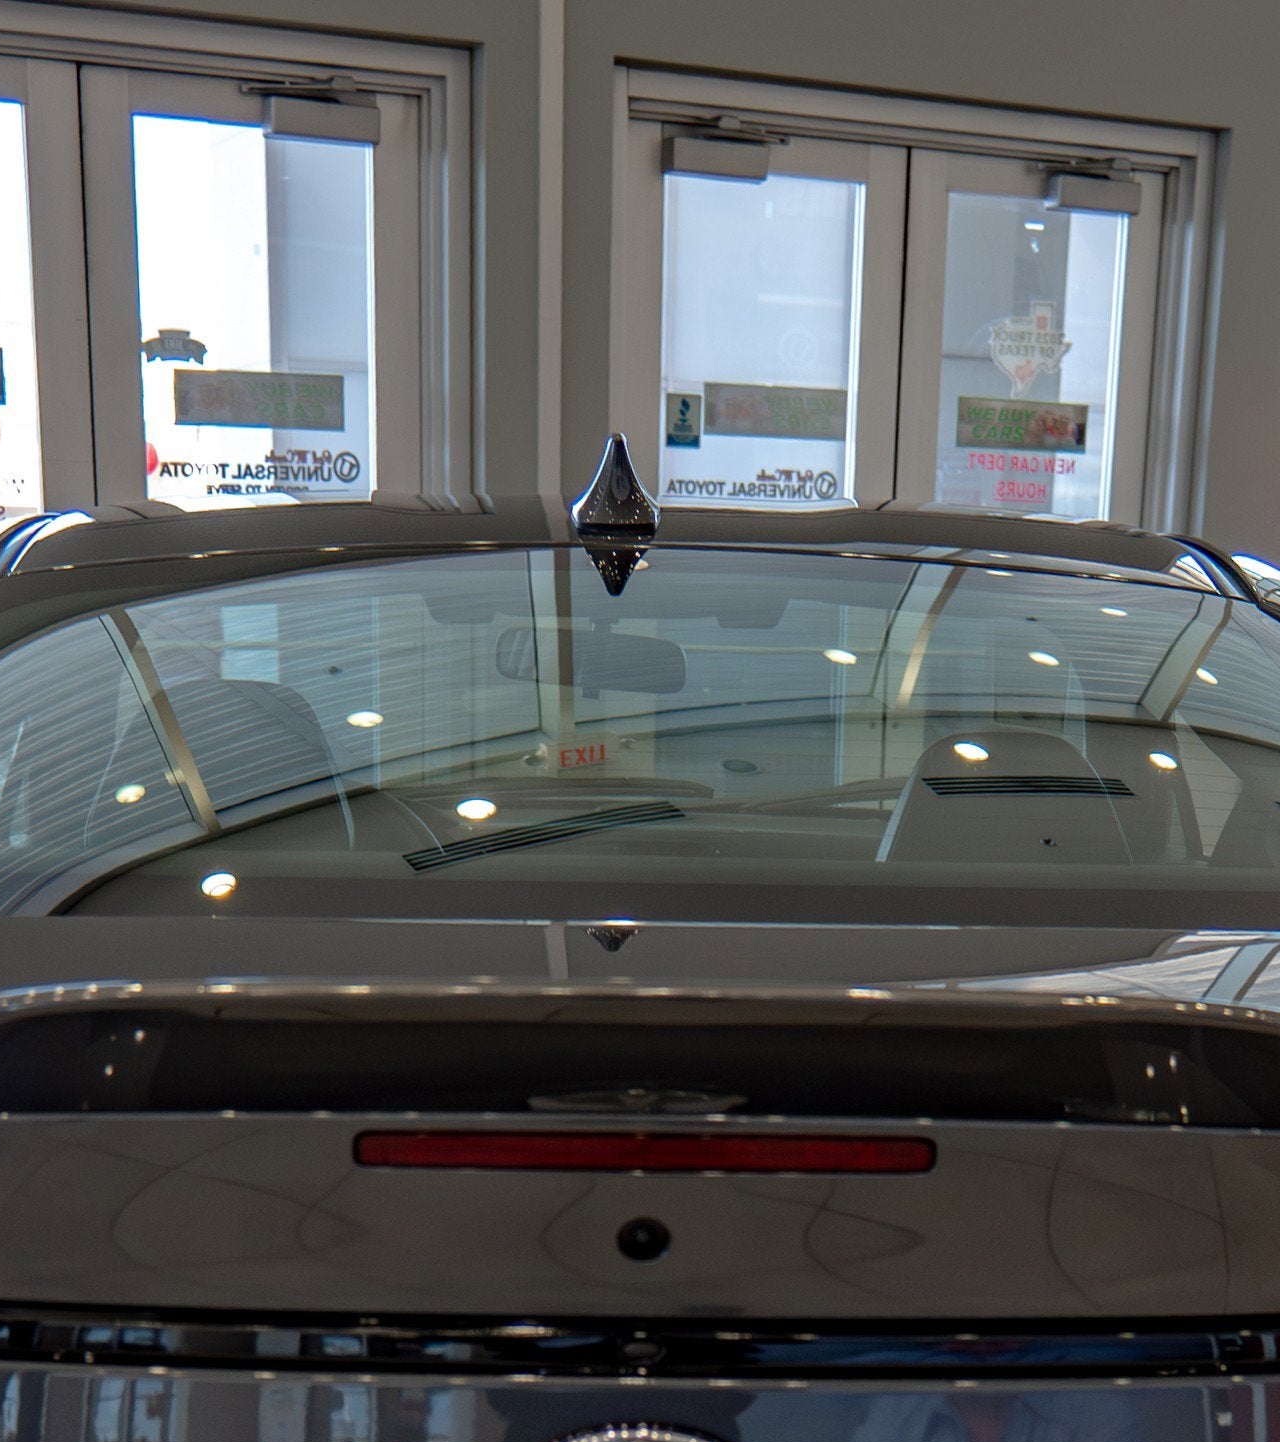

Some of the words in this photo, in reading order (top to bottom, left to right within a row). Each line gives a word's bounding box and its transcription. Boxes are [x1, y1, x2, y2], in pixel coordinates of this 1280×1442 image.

[966, 406, 995, 421] WE
[998, 407, 1036, 423] BUY
[971, 424, 1025, 442] CARS
